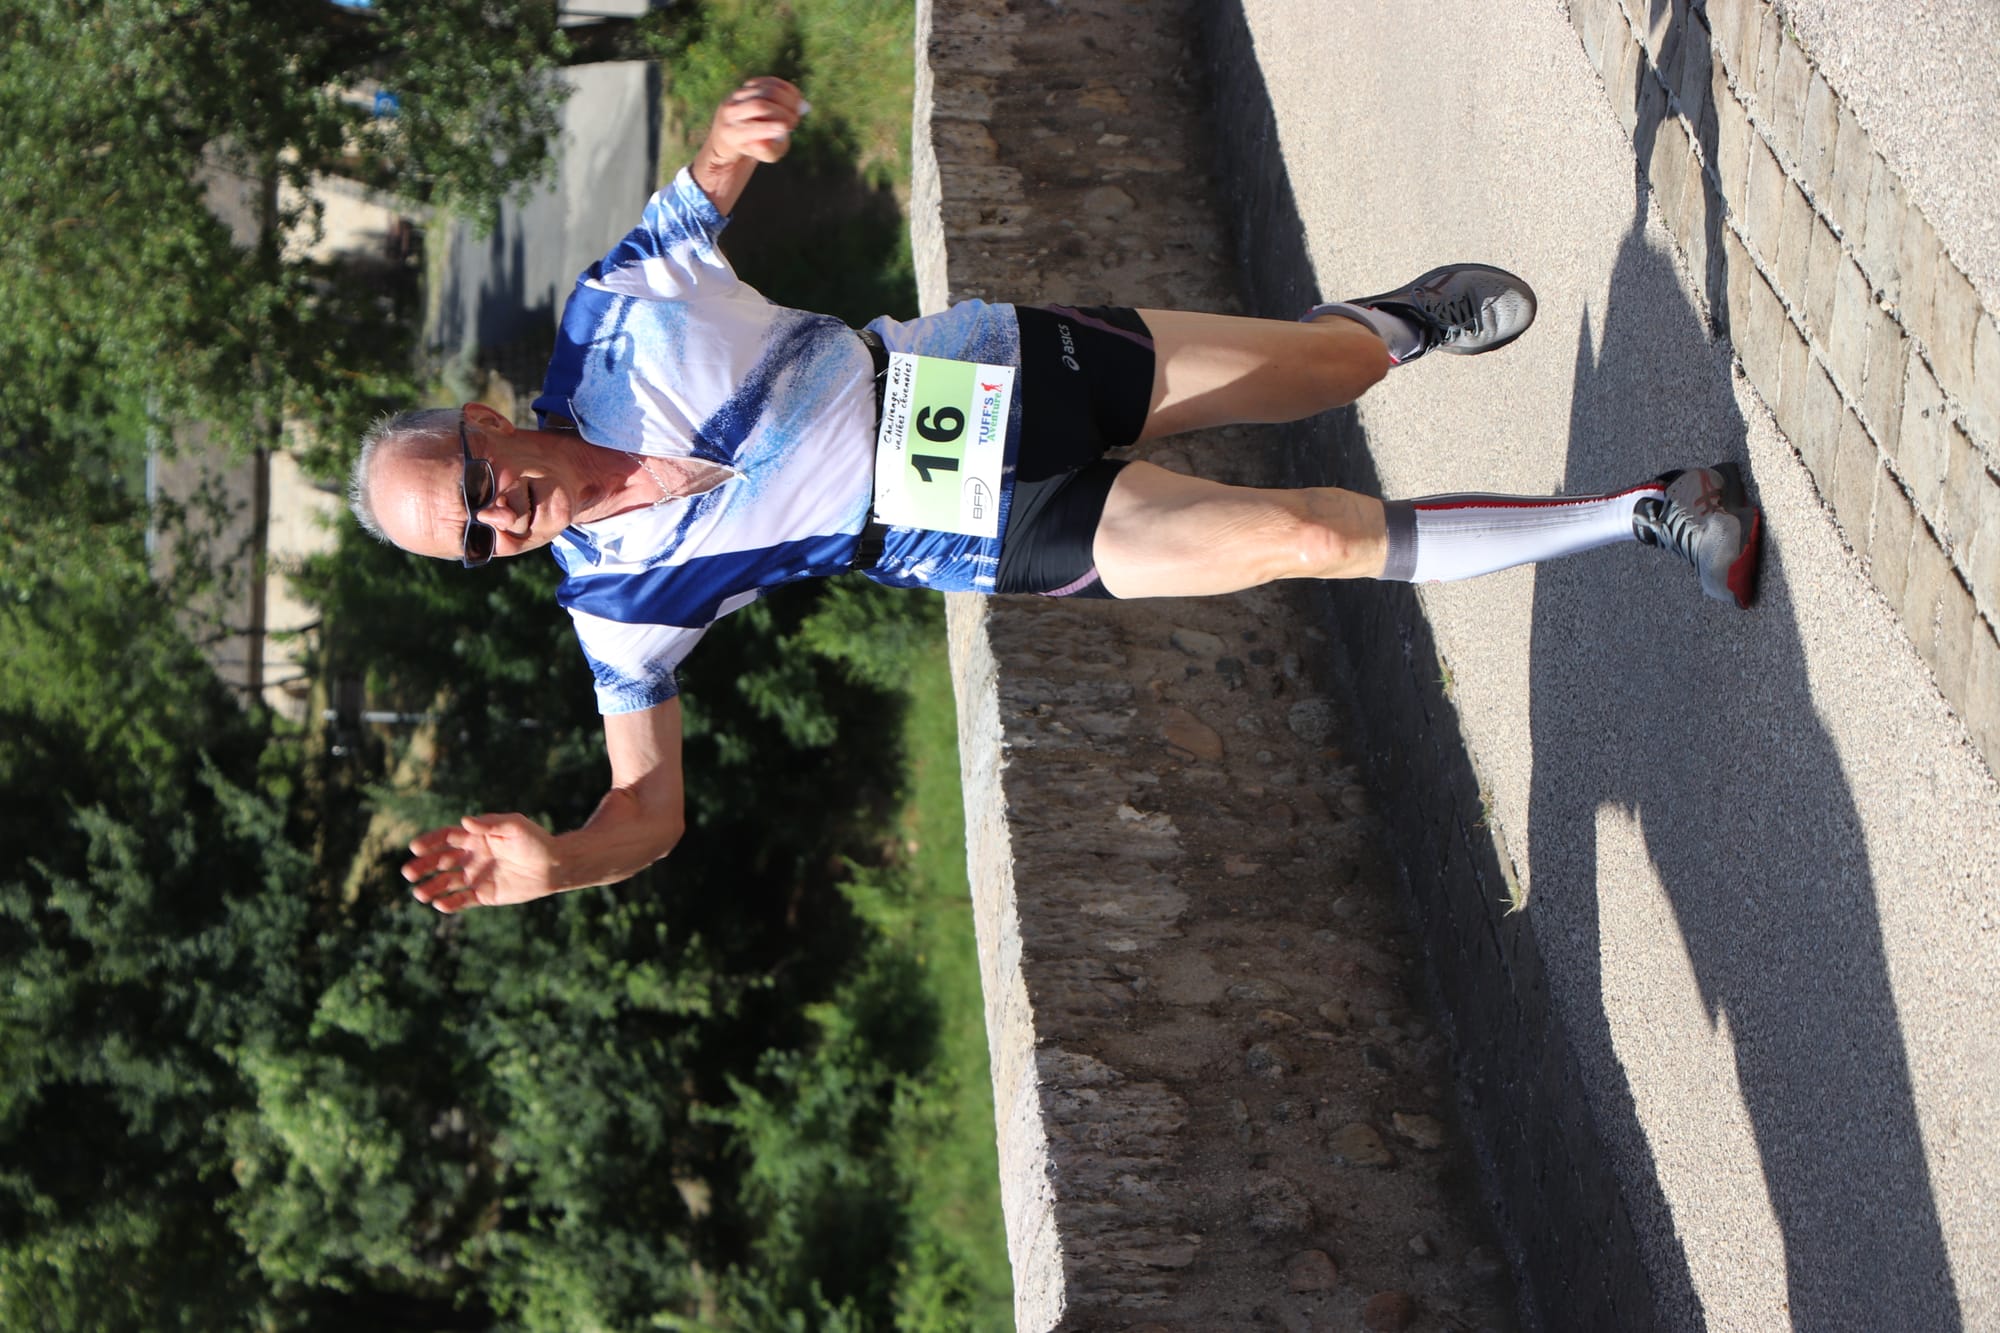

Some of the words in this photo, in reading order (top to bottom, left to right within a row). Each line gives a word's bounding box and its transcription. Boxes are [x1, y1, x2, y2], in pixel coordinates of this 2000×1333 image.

[1058, 323, 1075, 354] asics
[883, 391, 900, 444] Challenge
[893, 366, 902, 385] des
[979, 397, 994, 445] TUFF'S
[987, 393, 1002, 441] Aventure
[895, 415, 905, 451] vallées
[911, 406, 965, 483] 16
[973, 484, 984, 519] BFP
